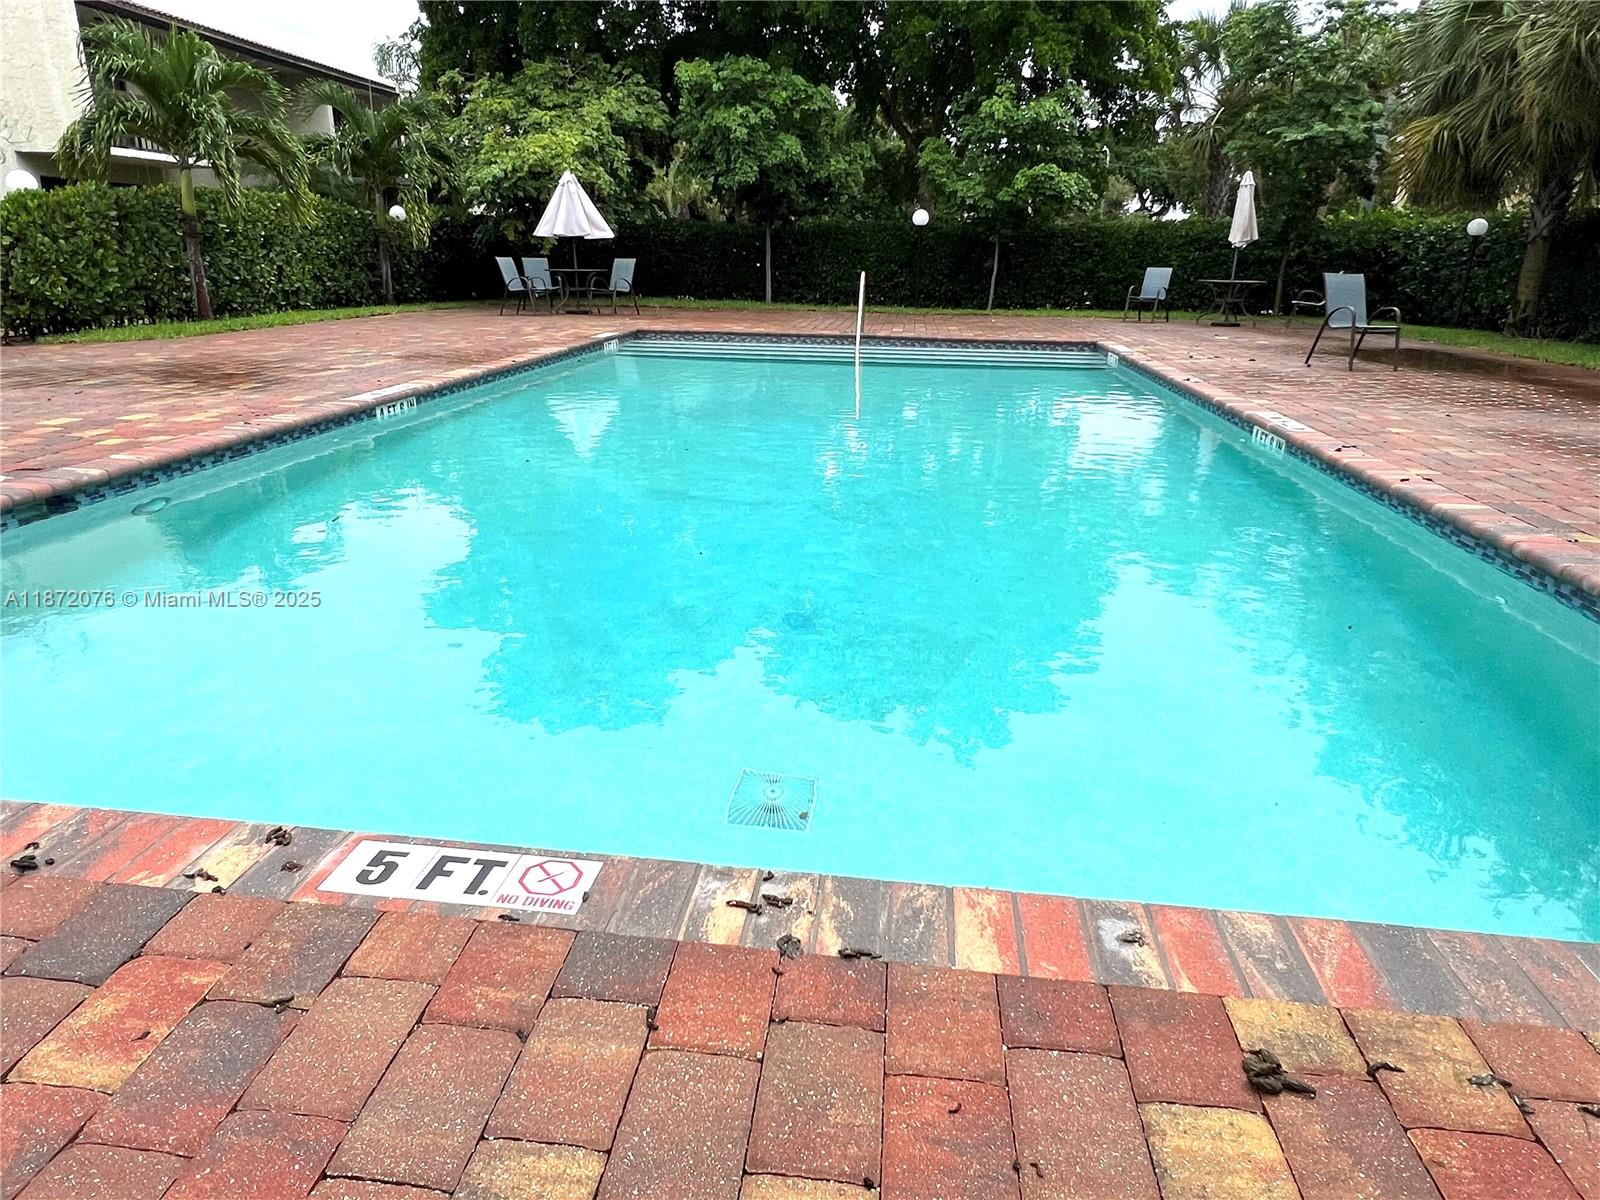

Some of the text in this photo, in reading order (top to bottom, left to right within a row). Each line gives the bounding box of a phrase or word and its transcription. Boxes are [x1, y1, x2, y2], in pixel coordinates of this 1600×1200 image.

[355, 850, 509, 896] 5 FT.
[496, 894, 576, 911] NO DIVING
